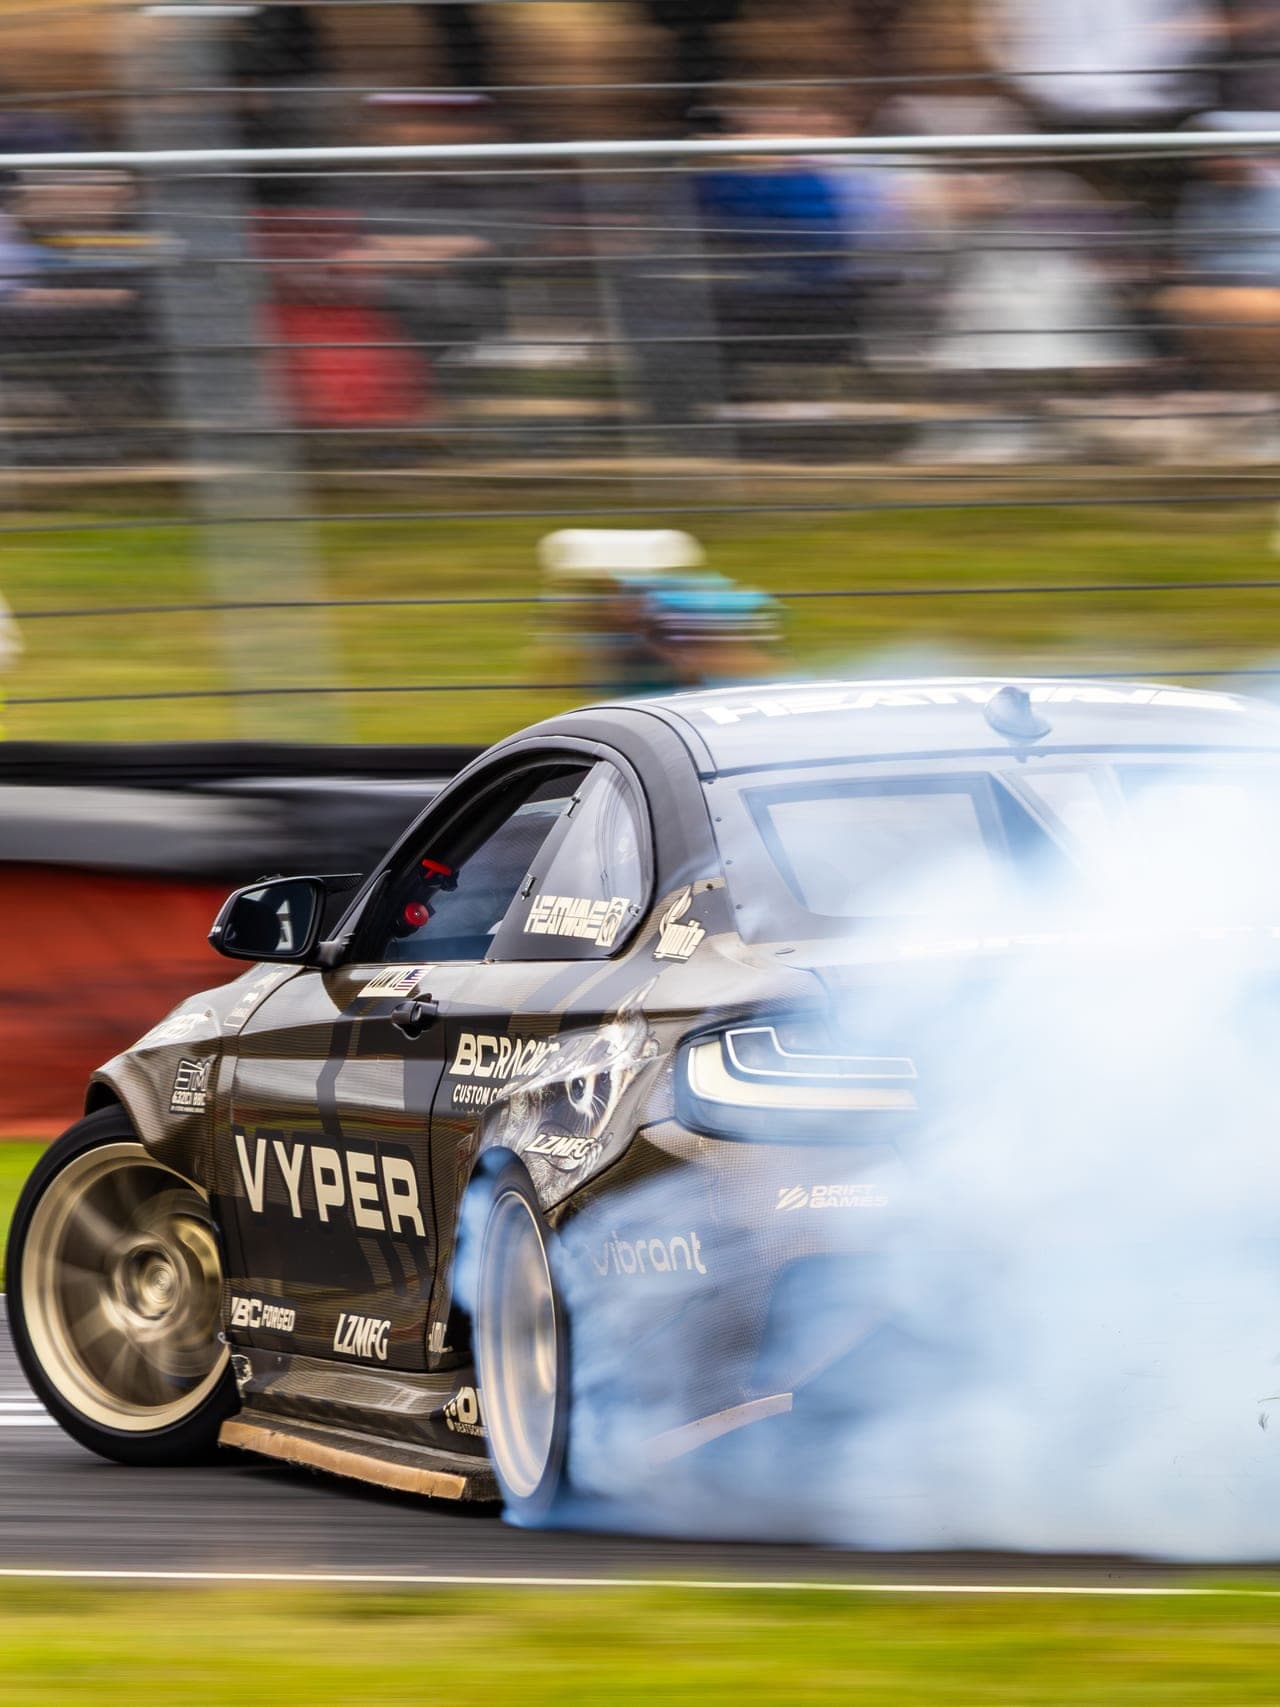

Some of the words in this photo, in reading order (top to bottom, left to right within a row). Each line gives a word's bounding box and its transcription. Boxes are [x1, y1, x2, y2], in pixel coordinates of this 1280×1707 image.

[453, 1084, 491, 1105] CUSTOM
[524, 1133, 596, 1158] LZMFG
[235, 1134, 426, 1237] VYPER
[810, 1184, 878, 1197] DRIFT
[809, 1196, 888, 1209] GAMES
[262, 1304, 296, 1332] FORGED
[333, 1313, 391, 1360] LZMFG
